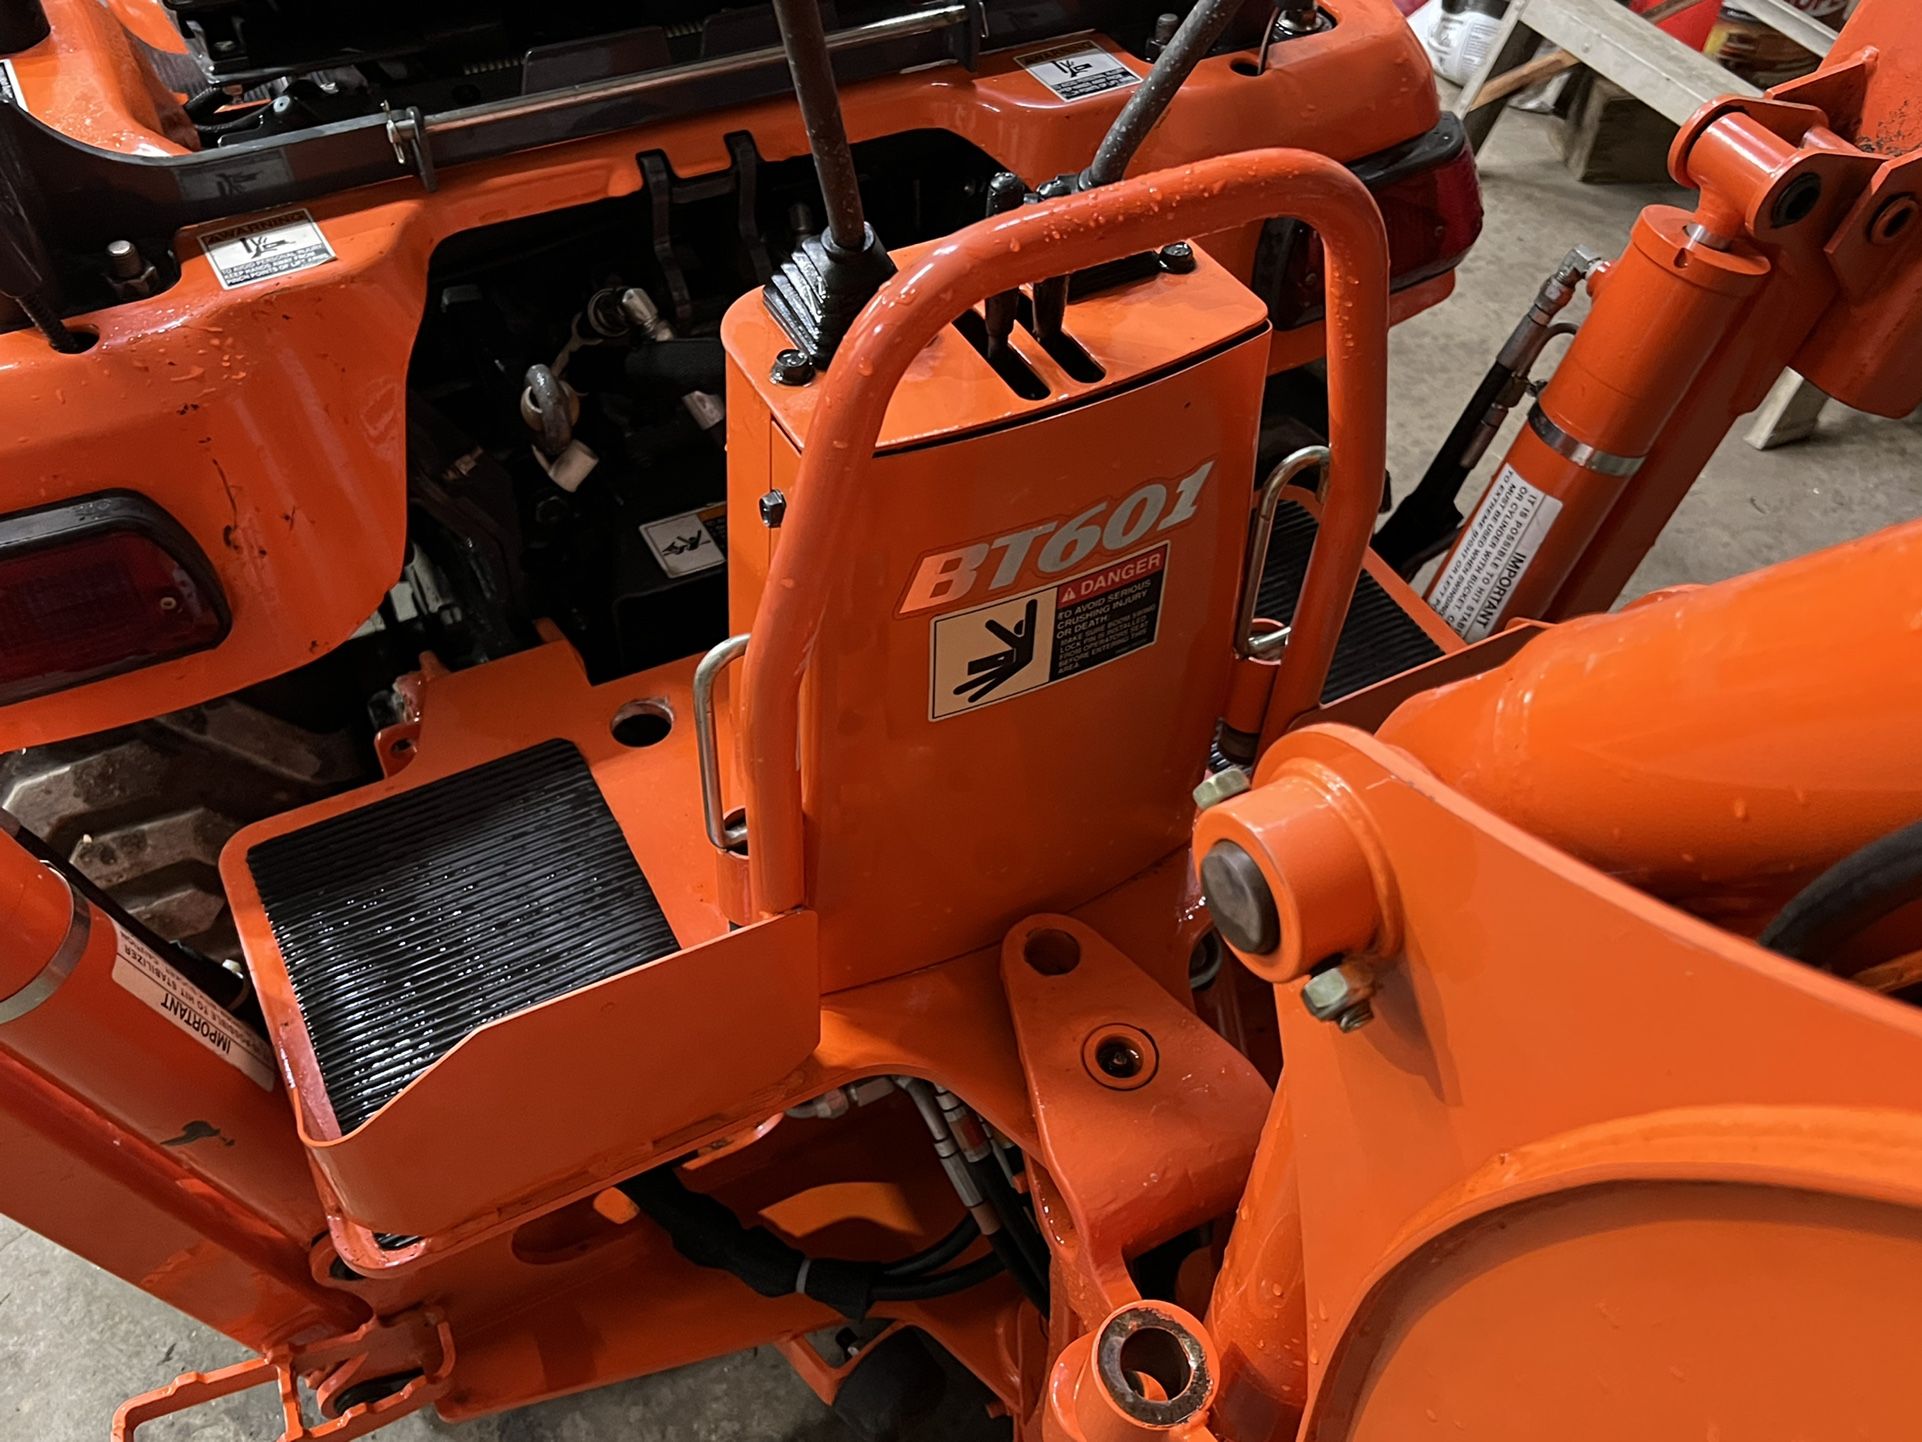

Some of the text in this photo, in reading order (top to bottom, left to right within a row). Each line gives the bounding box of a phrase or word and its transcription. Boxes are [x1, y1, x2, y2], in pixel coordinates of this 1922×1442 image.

[212, 211, 305, 242] WARNING
[1501, 469, 1513, 484] TO
[1475, 484, 1505, 530] EXTREME
[1497, 482, 1516, 510] MUST
[1514, 485, 1528, 502] OR
[1525, 493, 1537, 506] IT
[1487, 501, 1519, 549] CYLINDER
[1490, 509, 1501, 522] BE
[1518, 505, 1530, 519] IS
[899, 460, 1216, 614] BT601
[1476, 522, 1494, 547] USED
[1489, 519, 1523, 568] POSSIBLE
[1079, 551, 1161, 597] DANGER
[1450, 559, 1463, 574] OR
[1460, 548, 1480, 574] WHEN
[1473, 549, 1492, 574] WITH
[1437, 574, 1455, 597] LEFT
[1473, 550, 1526, 629] IMPORTANT
[1479, 570, 1494, 586] TO
[1056, 588, 1147, 631] CRUSHING INJURY
[1057, 577, 1152, 621] TO AVOID SERIOUS
[1469, 585, 1486, 604] HIT
[1055, 612, 1110, 640] OR DEATH:
[1058, 646, 1081, 661] FROM
[1082, 628, 1128, 652] OPERATORS
[1129, 620, 1148, 633] SEAT
[1059, 614, 1147, 654] LOCK PIN IS INSTALLED
[1060, 632, 1082, 647] MAKE
[1084, 623, 1105, 638] SURE
[1106, 614, 1130, 629] BOOM
[1057, 650, 1089, 668] BEFORE
[1090, 635, 1129, 655] ENTERING
[123, 942, 177, 992] STABILIZER
[160, 988, 231, 1055] IMPORTANT
